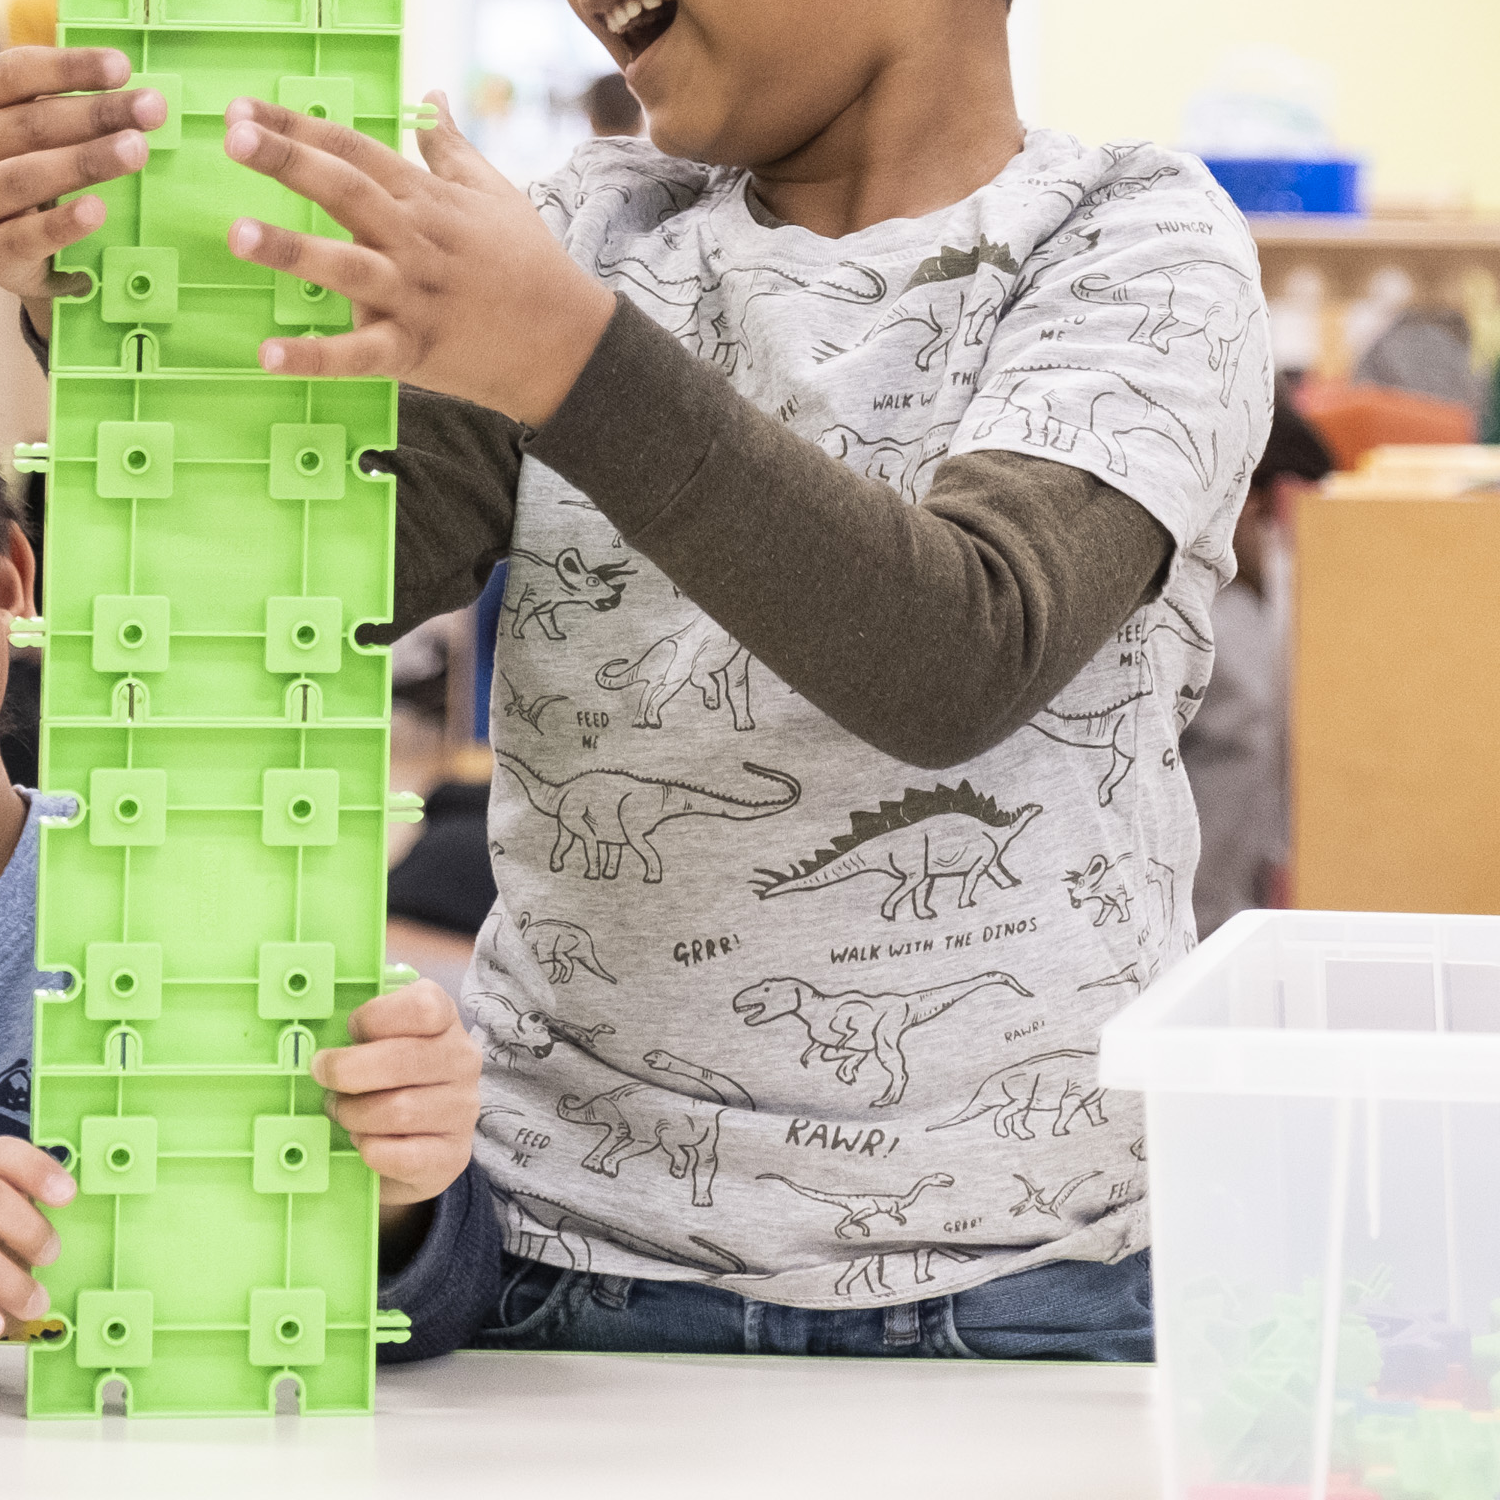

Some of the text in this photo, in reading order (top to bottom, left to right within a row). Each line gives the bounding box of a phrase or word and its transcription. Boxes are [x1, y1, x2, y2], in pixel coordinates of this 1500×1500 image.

[1039, 329, 1066, 342] ME
[874, 393, 914, 411] WALK
[1120, 651, 1141, 667] ME
[576, 710, 610, 729] FEED
[582, 736, 599, 750] ME
[830, 917, 1038, 964] WALK WITH THE DINOS
[673, 934, 741, 967] GRRR!
[515, 1127, 551, 1149] FEED
[785, 1118, 900, 1159] RAWR!
[510, 1150, 532, 1168] ME
